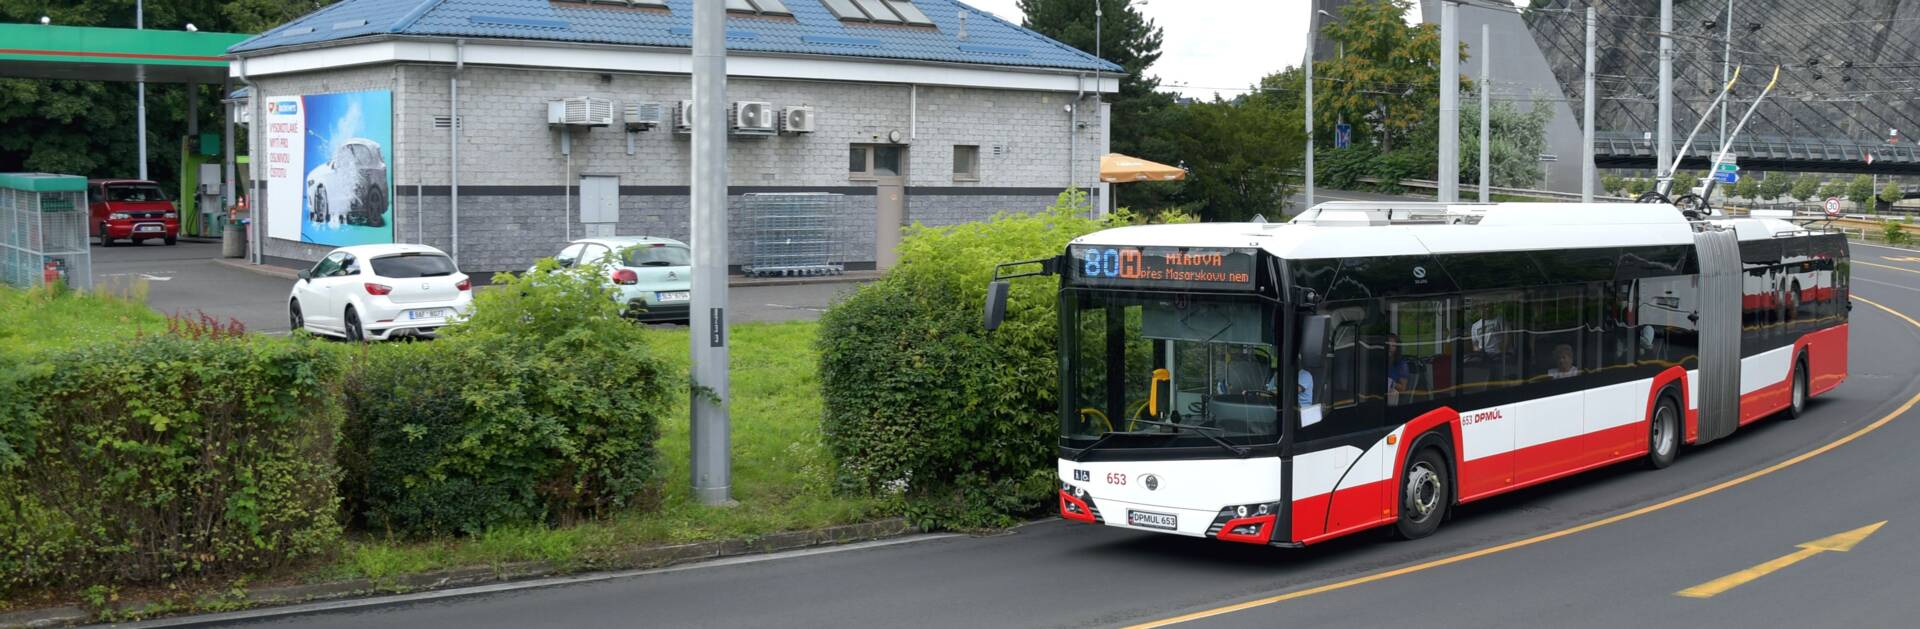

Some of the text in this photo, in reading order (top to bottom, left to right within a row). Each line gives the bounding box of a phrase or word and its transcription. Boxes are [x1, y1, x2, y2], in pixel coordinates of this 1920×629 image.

[1829, 202, 1837, 210] 30
[1085, 249, 1119, 277] 80
[1166, 251, 1222, 266] MÍROVÁ
[1165, 268, 1226, 282] Masarykovu
[1229, 272, 1249, 282] nem
[1462, 408, 1502, 426] 653 DPMÚL
[1106, 473, 1127, 485] 653
[1134, 513, 1175, 526] DPMUL 653
